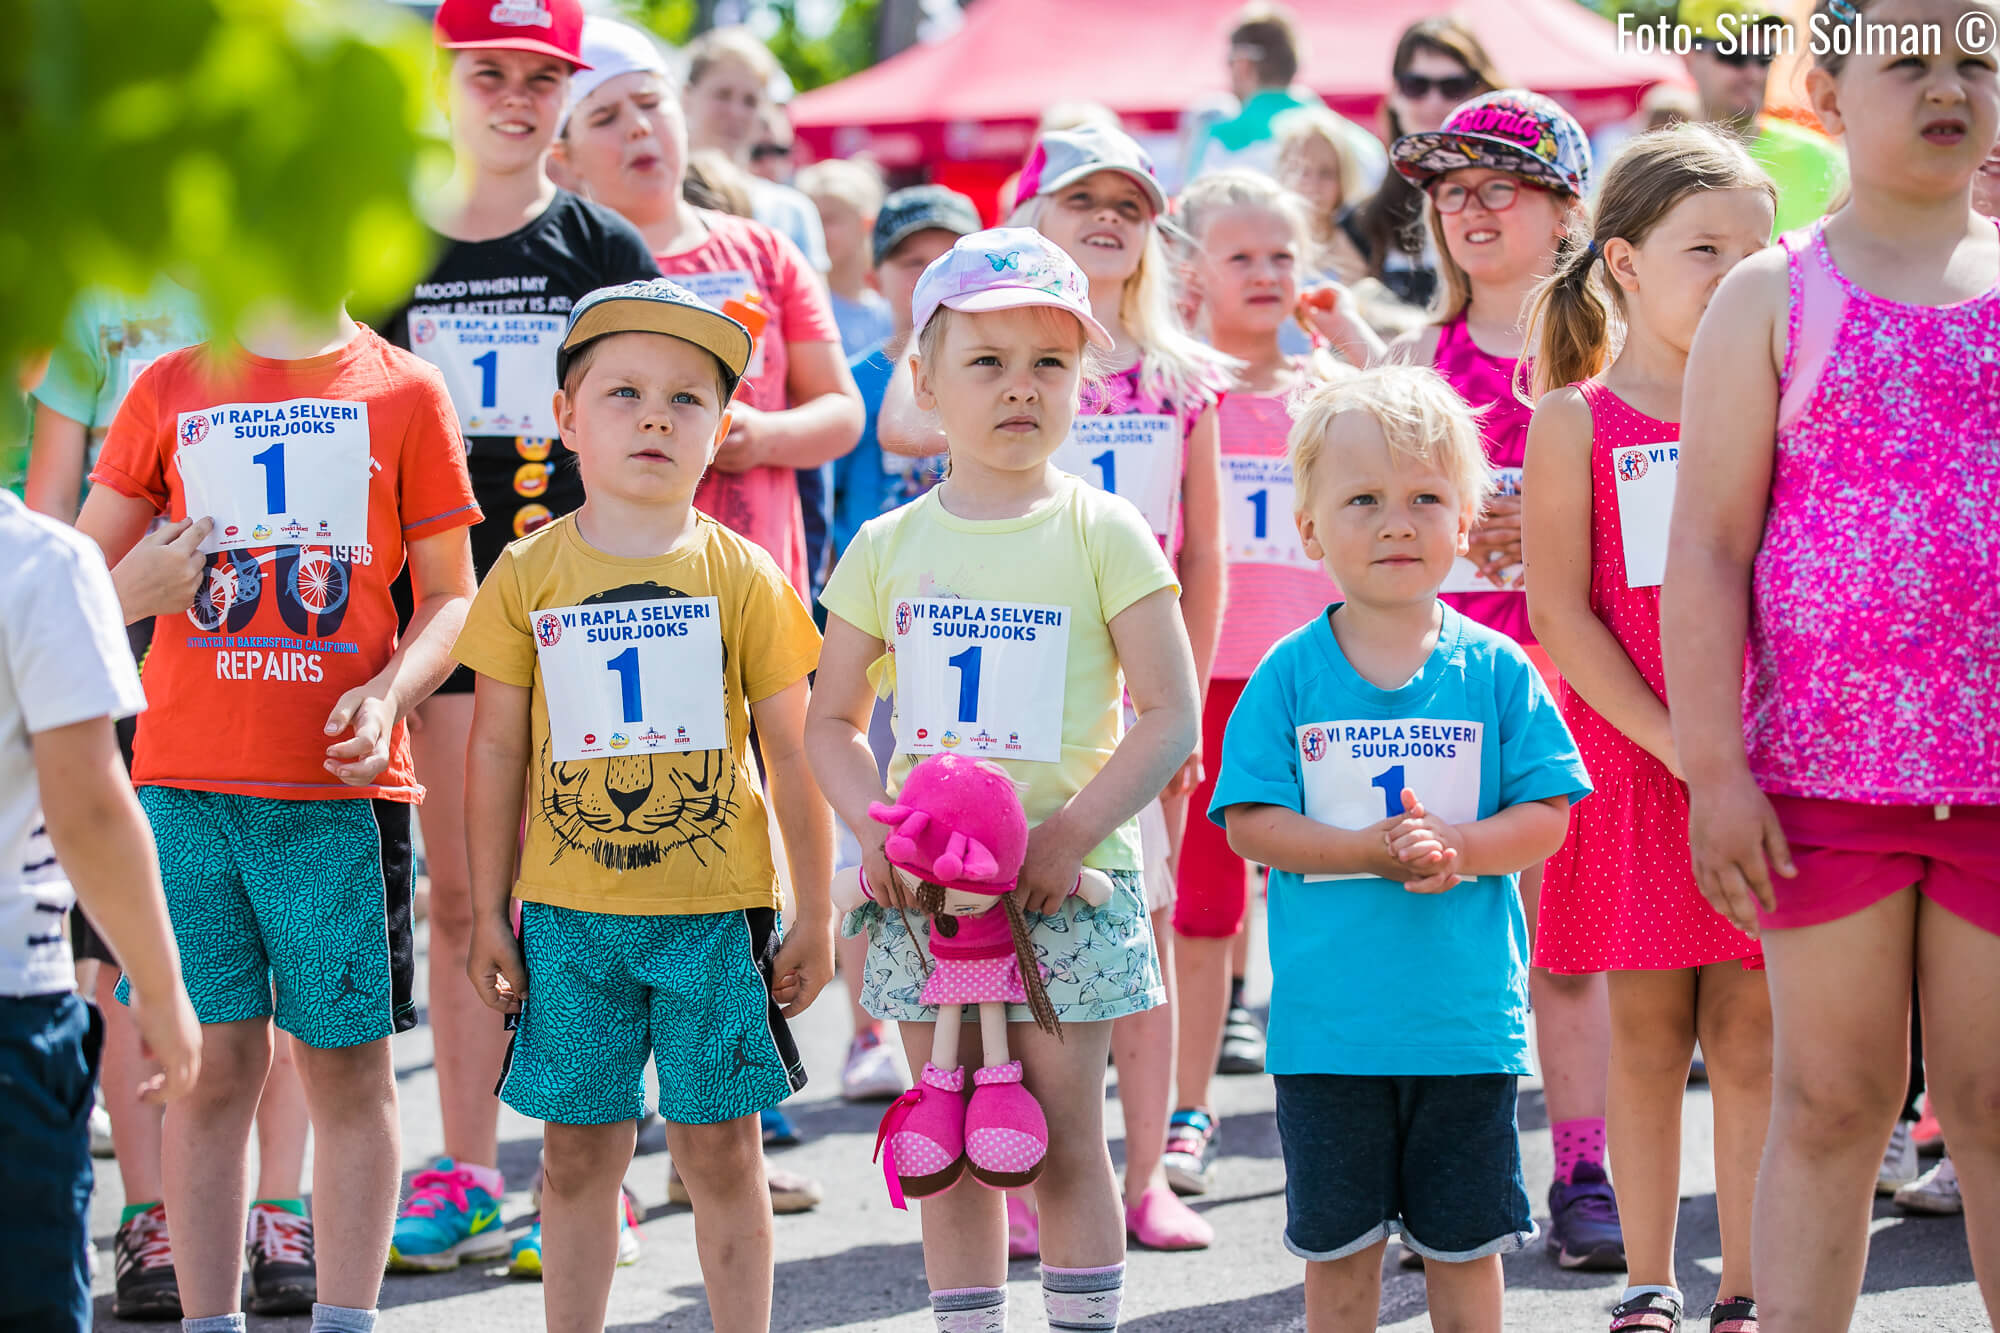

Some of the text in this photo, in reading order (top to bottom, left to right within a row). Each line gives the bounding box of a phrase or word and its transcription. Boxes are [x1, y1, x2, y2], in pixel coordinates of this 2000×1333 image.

[415, 275, 548, 299] MOOD WHEN MY
[454, 299, 528, 314] BATTERY
[530, 297, 546, 311] IS
[438, 320, 560, 332] VI RAPLA SELVERI
[459, 333, 540, 344] SUURJOOKS
[472, 350, 498, 408] 1
[211, 404, 358, 426] VI RAPLA SELVERI
[1119, 420, 1170, 431] SELVERI
[234, 421, 336, 439] SUURJOOKS
[1648, 449, 1665, 463] VI
[253, 443, 286, 515] 1
[1091, 450, 1115, 494] 1
[1246, 489, 1267, 539] 1
[331, 544, 373, 566] 1996
[561, 603, 710, 628] VI RAPLA SELVERI
[913, 604, 925, 618] VI
[929, 604, 986, 621] RAPLA
[990, 607, 1062, 626] SELVERI
[587, 622, 689, 643] SUURJOOKS
[932, 622, 1036, 641] SUURJOOKS
[225, 637, 235, 648] IN
[237, 637, 302, 650] BAKERSFIELD
[305, 641, 359, 654] CALIFORNIA
[216, 650, 324, 683] REPAIRS
[607, 646, 643, 723] 1
[948, 646, 982, 722] 1
[1326, 725, 1476, 743] VI RAPLA SELVERI
[1351, 743, 1457, 759] SUURJOOKS
[1371, 765, 1405, 819] 1
